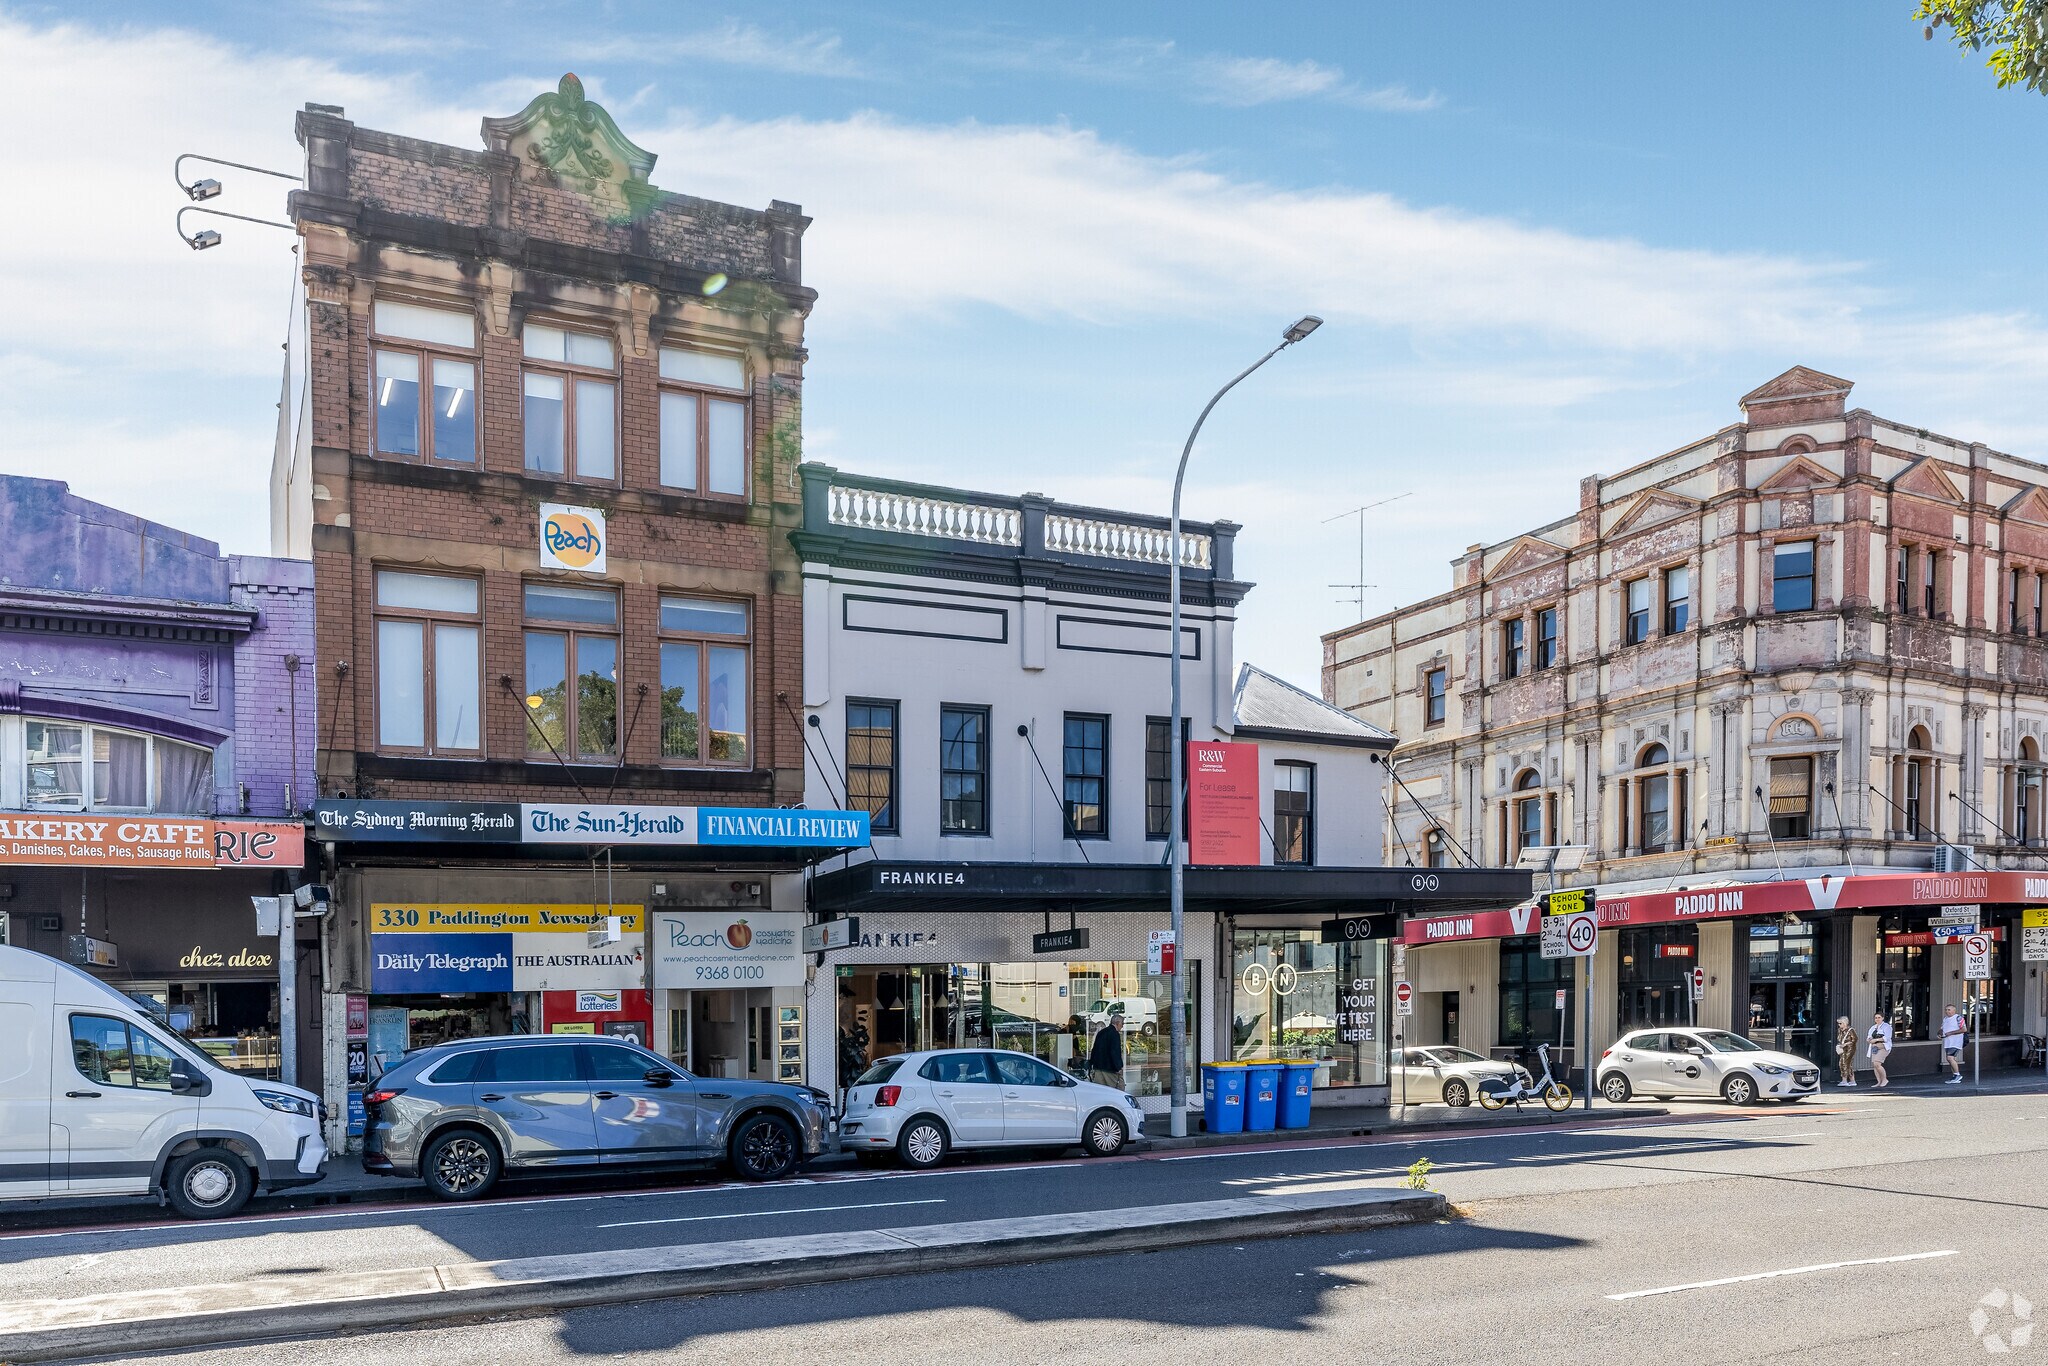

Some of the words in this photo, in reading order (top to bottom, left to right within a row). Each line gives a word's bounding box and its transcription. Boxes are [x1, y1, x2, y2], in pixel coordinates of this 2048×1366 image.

[544, 520, 602, 557] Peach
[1198, 749, 1226, 762] R&W
[1199, 783, 1211, 791] For
[1213, 784, 1236, 792] Lease
[319, 810, 349, 828] The
[351, 810, 405, 830] Sydney
[409, 811, 468, 831] Morning
[471, 812, 516, 832] Herald
[530, 810, 571, 833] The
[573, 811, 685, 838] Sun-Herald
[706, 815, 796, 836] FINANCIAL
[799, 817, 862, 839] REVIEW
[116, 822, 205, 845] CAFE
[12, 841, 67, 858] Danishes,
[69, 843, 107, 859] Cakes,
[108, 845, 135, 860] Pies,
[136, 846, 183, 861] Sausage
[184, 847, 214, 862] Rolls,
[880, 871, 965, 884] FRANKIE4
[1913, 877, 1961, 900] PADDO
[1963, 876, 1989, 898] INN
[1551, 893, 1583, 904] SCHOOL
[1675, 893, 1716, 915] PADDO
[1718, 890, 1744, 912] INN
[1556, 902, 1578, 912] ZONE
[1608, 902, 1630, 921] INN
[1945, 906, 1963, 914] Oxford
[378, 909, 420, 927] 330
[427, 910, 530, 929] Paddington
[538, 910, 638, 929] Newsagcy
[1930, 917, 1956, 925] William
[663, 919, 750, 951] Peach
[1426, 920, 1454, 939] PADDO
[1455, 918, 1473, 936] INN
[1571, 926, 1592, 942] 40
[1941, 927, 1956, 935] 50+
[860, 932, 937, 947] ANKIE4
[1040, 934, 1073, 948] FRANKIE4
[1543, 941, 1565, 949] SCHOOL
[1892, 935, 1913, 945] PADDO
[1914, 934, 1927, 945] INN
[179, 945, 224, 968] chez
[227, 947, 273, 967] alex
[1667, 946, 1681, 956] PADDO
[377, 953, 423, 972] Daily
[425, 953, 509, 972] Telegraph
[514, 954, 545, 968] THE
[545, 954, 635, 968] AUSTRALIAN
[662, 954, 796, 964] www.peachcosmeticmedicine.com
[1969, 956, 1984, 964] NO
[695, 966, 730, 980] 9368
[733, 965, 764, 979] 0100
[1352, 978, 1376, 991] GET
[579, 1001, 618, 1011] Lotteries
[1343, 995, 1376, 1008] YOUR
[1349, 1012, 1376, 1025] TEST
[1343, 1029, 1376, 1042] HERE.
